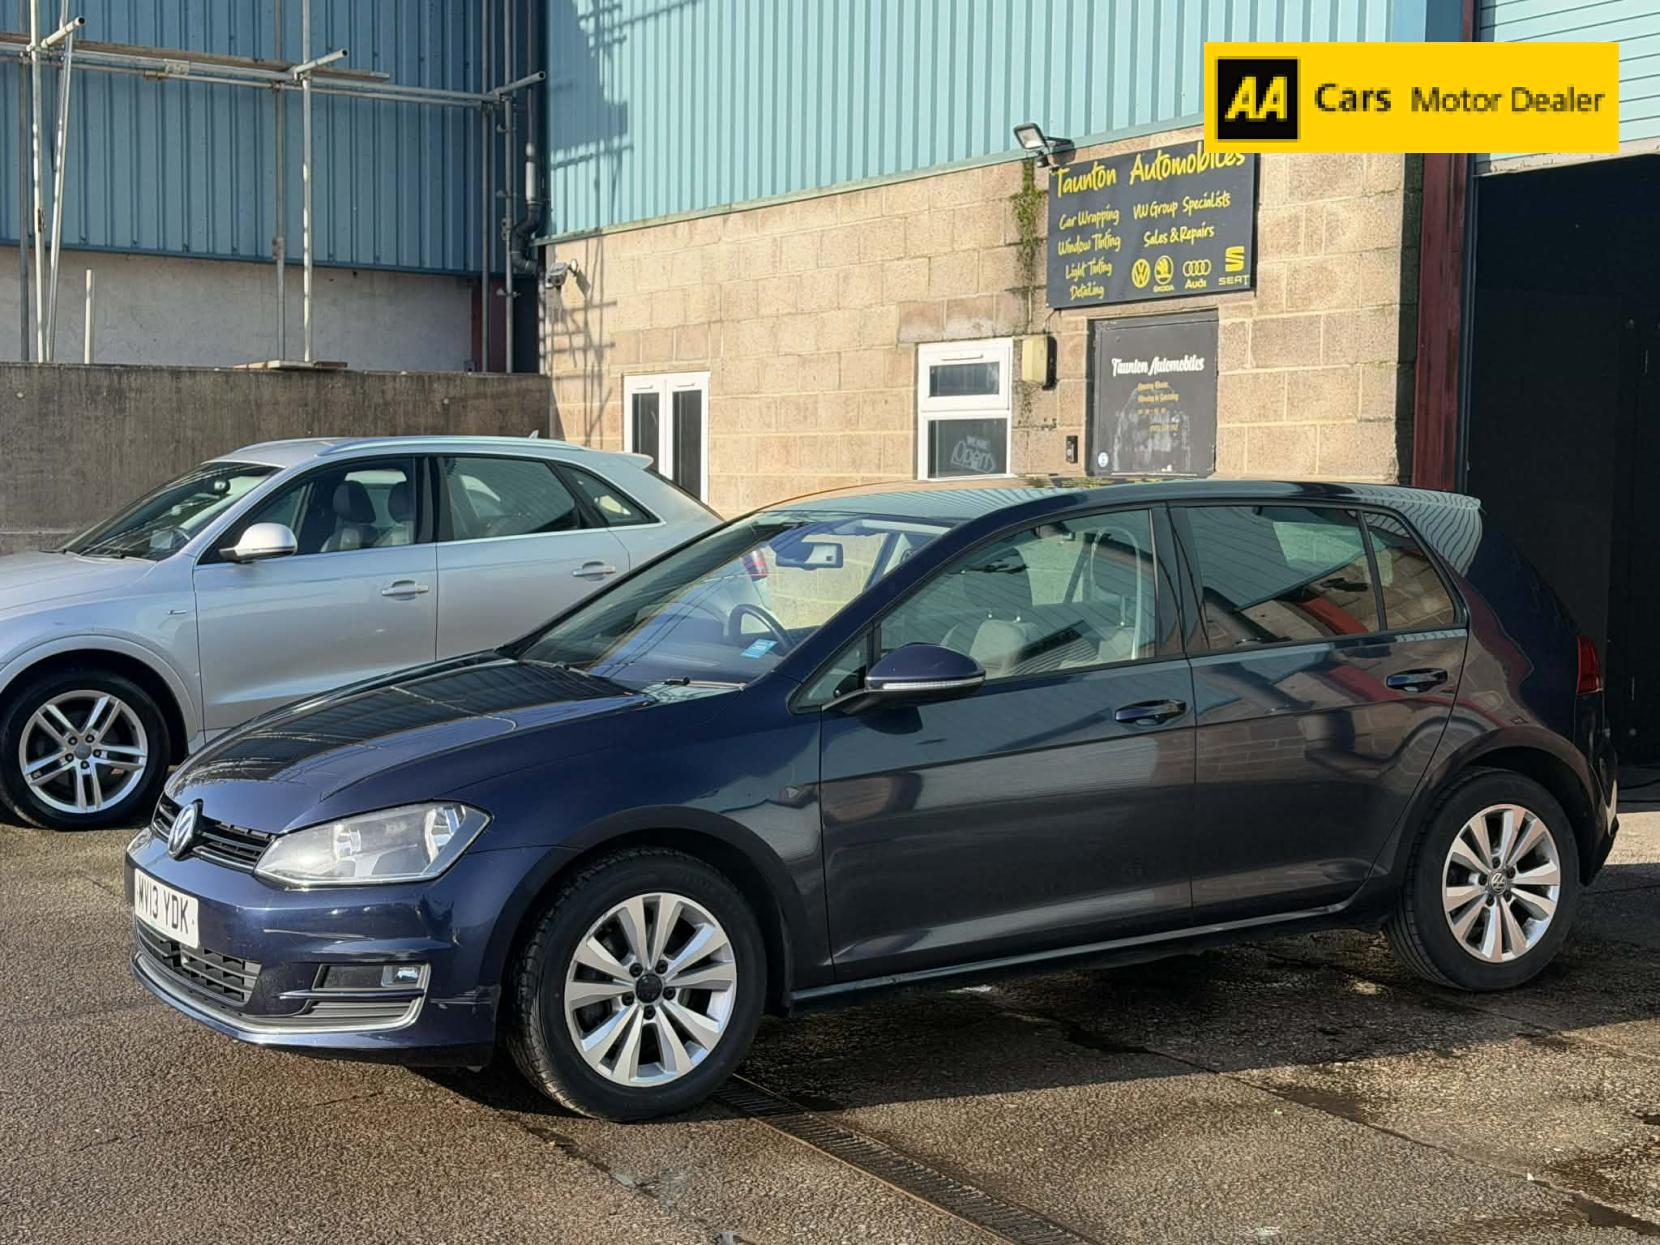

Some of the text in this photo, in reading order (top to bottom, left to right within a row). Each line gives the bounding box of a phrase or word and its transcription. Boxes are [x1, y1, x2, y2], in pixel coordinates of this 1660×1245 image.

[1052, 161, 1117, 198] Taunton
[1059, 204, 1120, 230] Car Wrapping
[1133, 190, 1232, 220] VW Group Specialists
[1058, 229, 1121, 255] Window Tinting
[1143, 221, 1215, 248] Sales & Repairs
[1065, 257, 1112, 281] Light Tinting
[1218, 274, 1250, 286] SEAT
[1184, 278, 1207, 290] Audi
[163, 889, 189, 935] YDK
